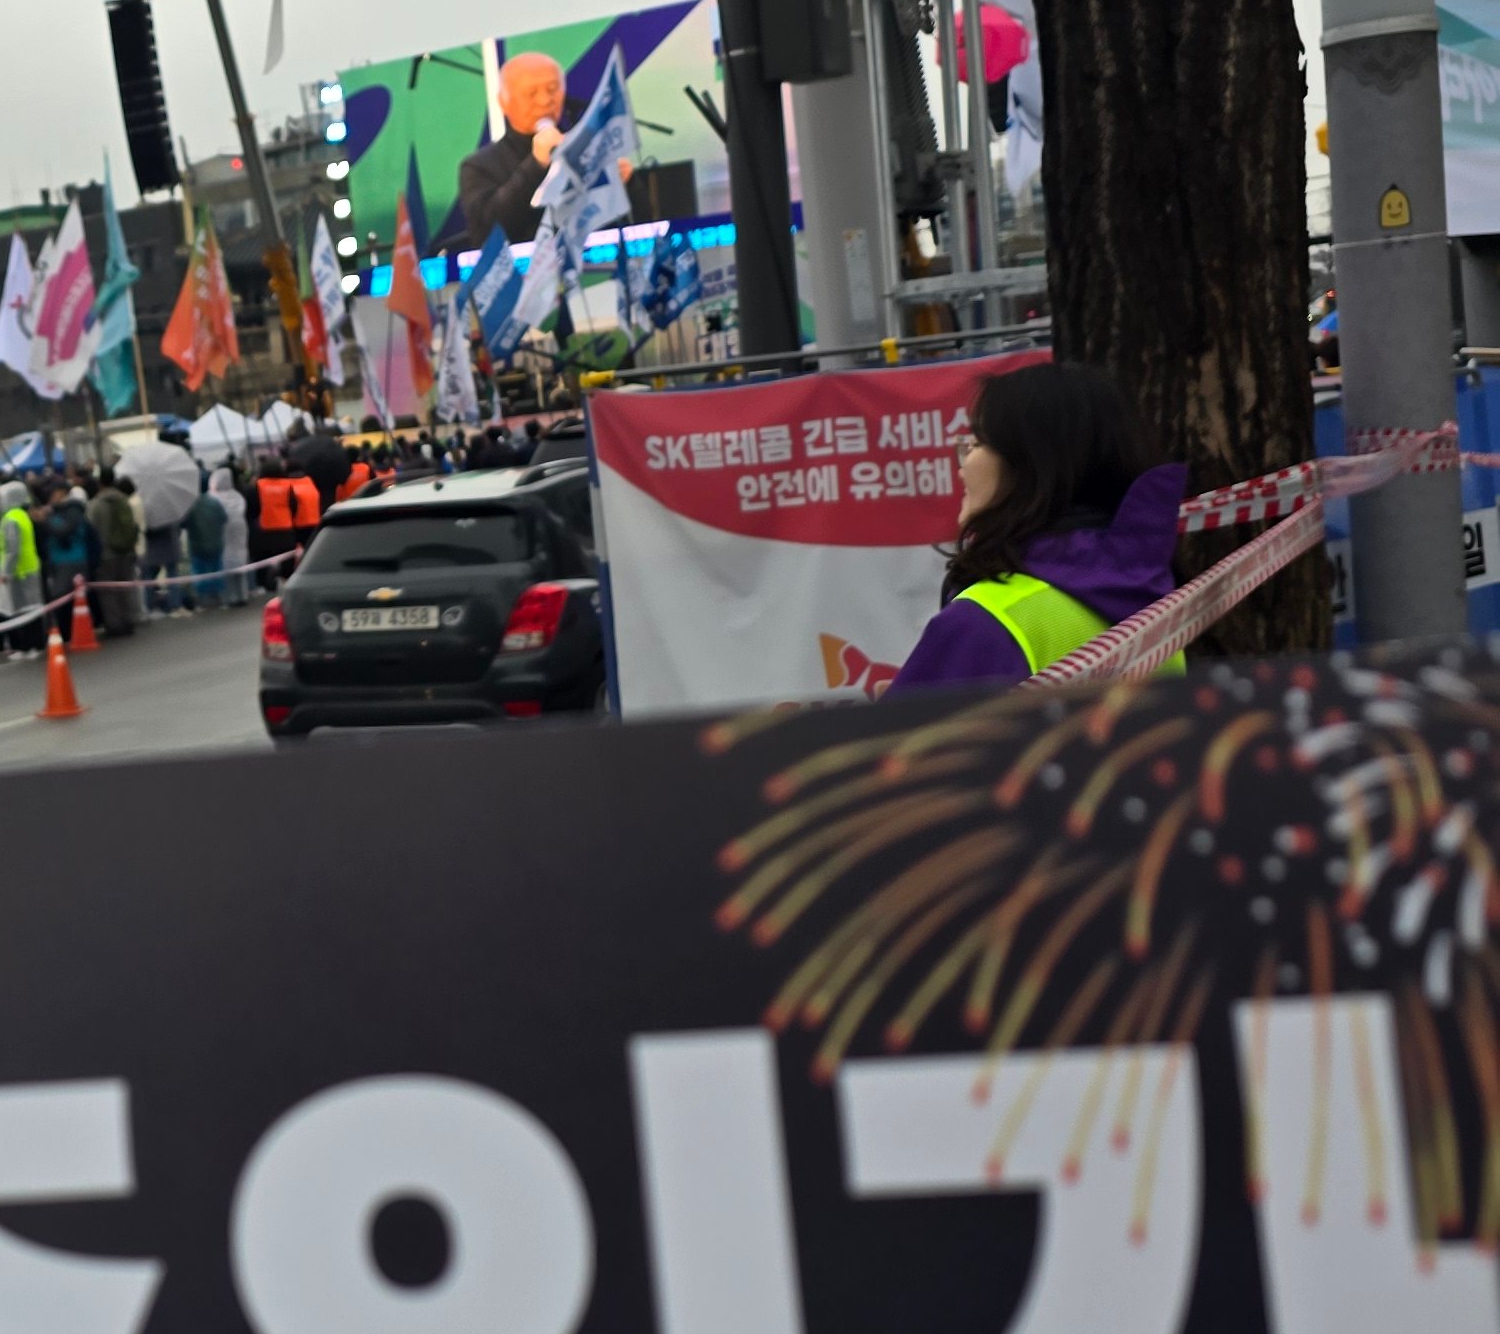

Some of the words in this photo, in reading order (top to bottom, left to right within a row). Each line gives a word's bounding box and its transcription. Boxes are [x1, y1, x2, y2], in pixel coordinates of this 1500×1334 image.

[644, 424, 793, 471] SK텔레콤
[802, 416, 869, 457] 긴급
[736, 465, 841, 512] 안전에
[849, 457, 953, 501] 유의해
